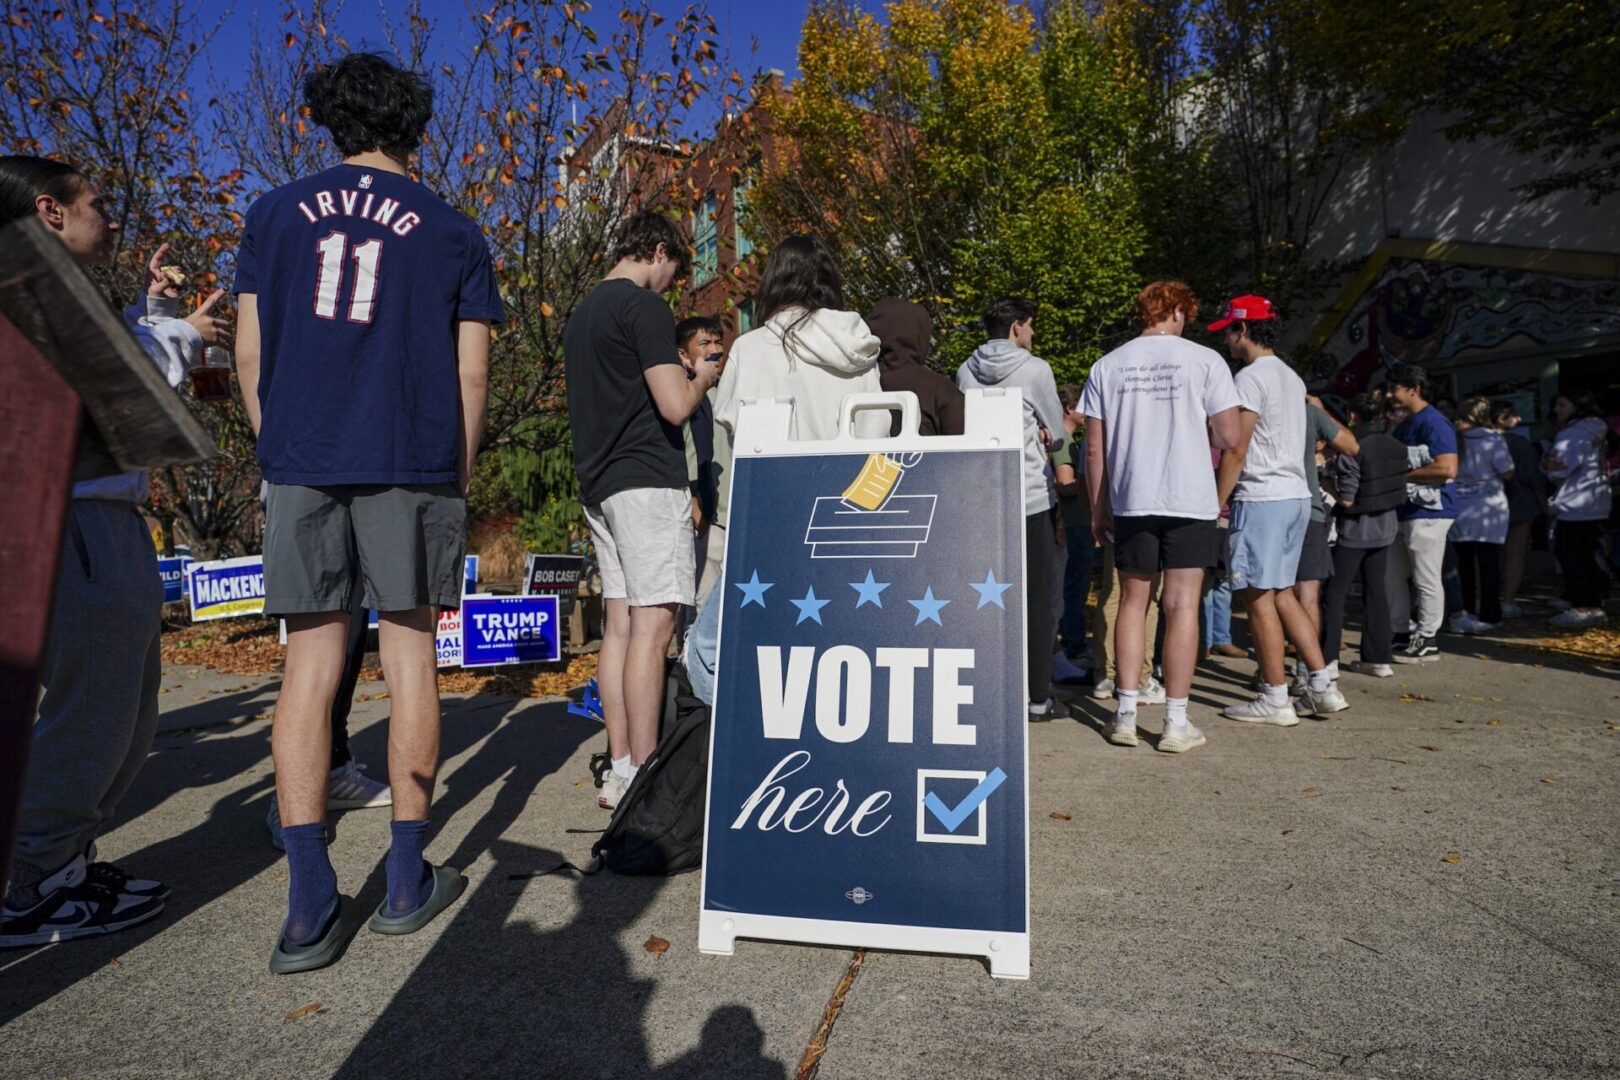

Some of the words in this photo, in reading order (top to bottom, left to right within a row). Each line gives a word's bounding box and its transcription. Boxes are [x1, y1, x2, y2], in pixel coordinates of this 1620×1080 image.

[298, 189, 422, 236] IRVING
[313, 230, 384, 323] 11
[1149, 363, 1159, 372] all
[1160, 361, 1182, 371] things
[1125, 375, 1151, 384] through
[1152, 374, 1174, 383] Christ
[534, 570, 554, 583] BOB
[555, 570, 580, 583] CASEY
[472, 611, 549, 629] TRUMP
[481, 627, 542, 643] VANCE
[756, 644, 977, 745] VOTE
[730, 750, 893, 838] here
